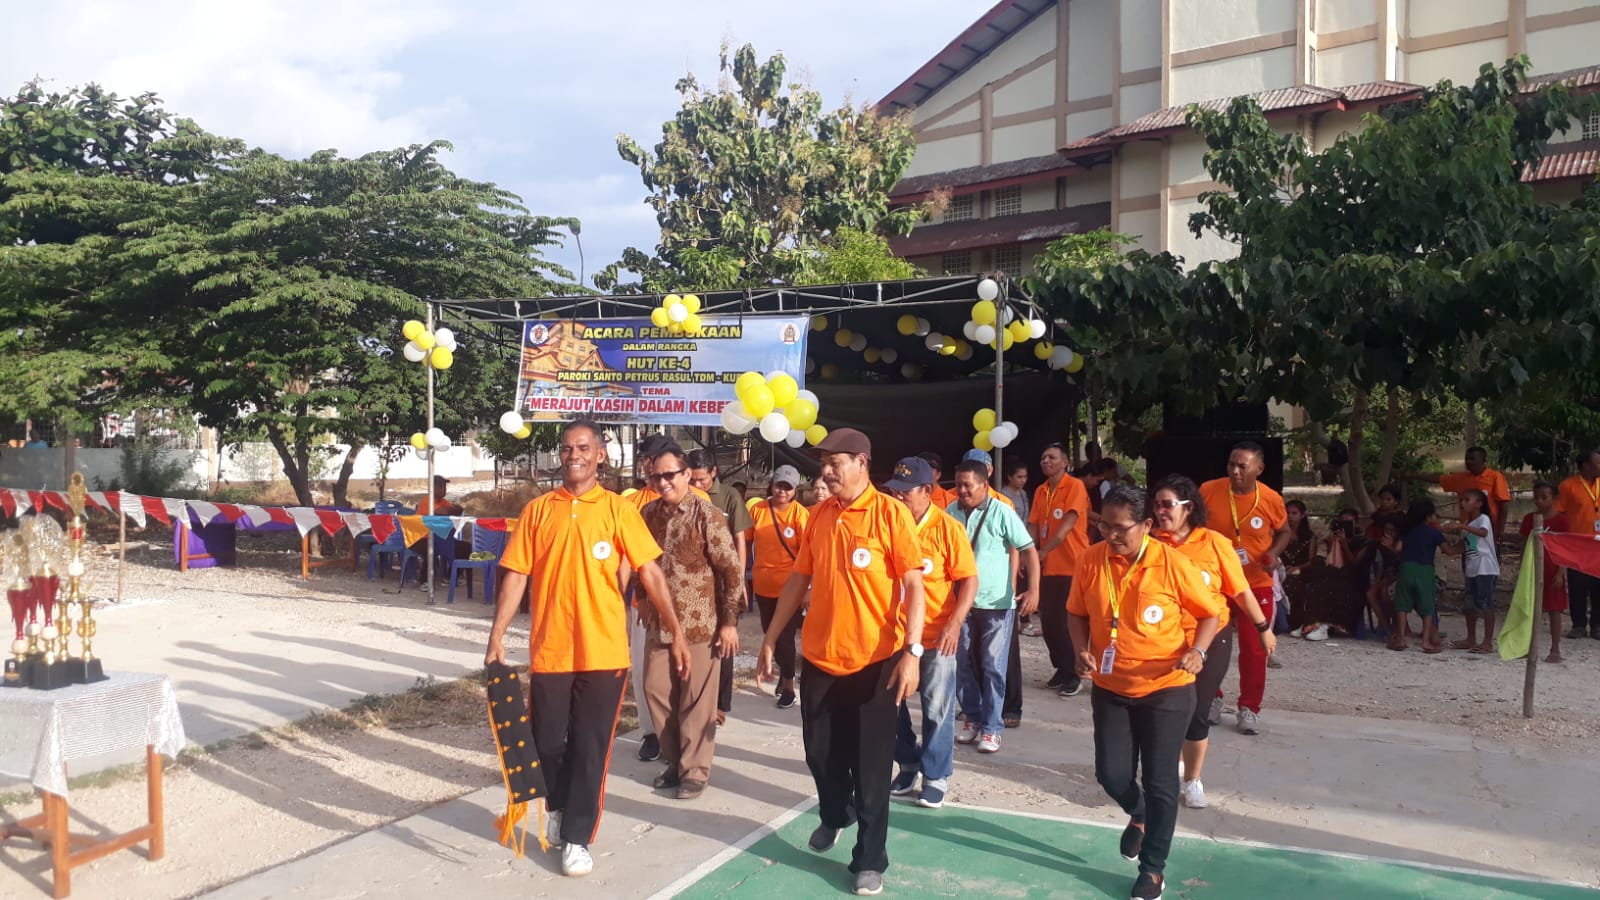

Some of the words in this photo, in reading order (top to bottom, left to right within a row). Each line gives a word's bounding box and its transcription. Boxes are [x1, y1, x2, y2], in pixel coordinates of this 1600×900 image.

[583, 327, 634, 339] ACARA
[622, 343, 655, 351] DALAM
[658, 343, 697, 351] RANGKA
[626, 357, 655, 369] HUT
[658, 357, 691, 369] KE-4
[558, 372, 591, 381] PAROKI
[593, 372, 622, 381] SANTO
[625, 372, 660, 382] PETRUS
[662, 373, 691, 382] RASUL
[694, 373, 714, 382] TDM
[595, 398, 634, 412] KASIH
[639, 399, 685, 413] DALAM
[689, 400, 731, 414] KEBE
